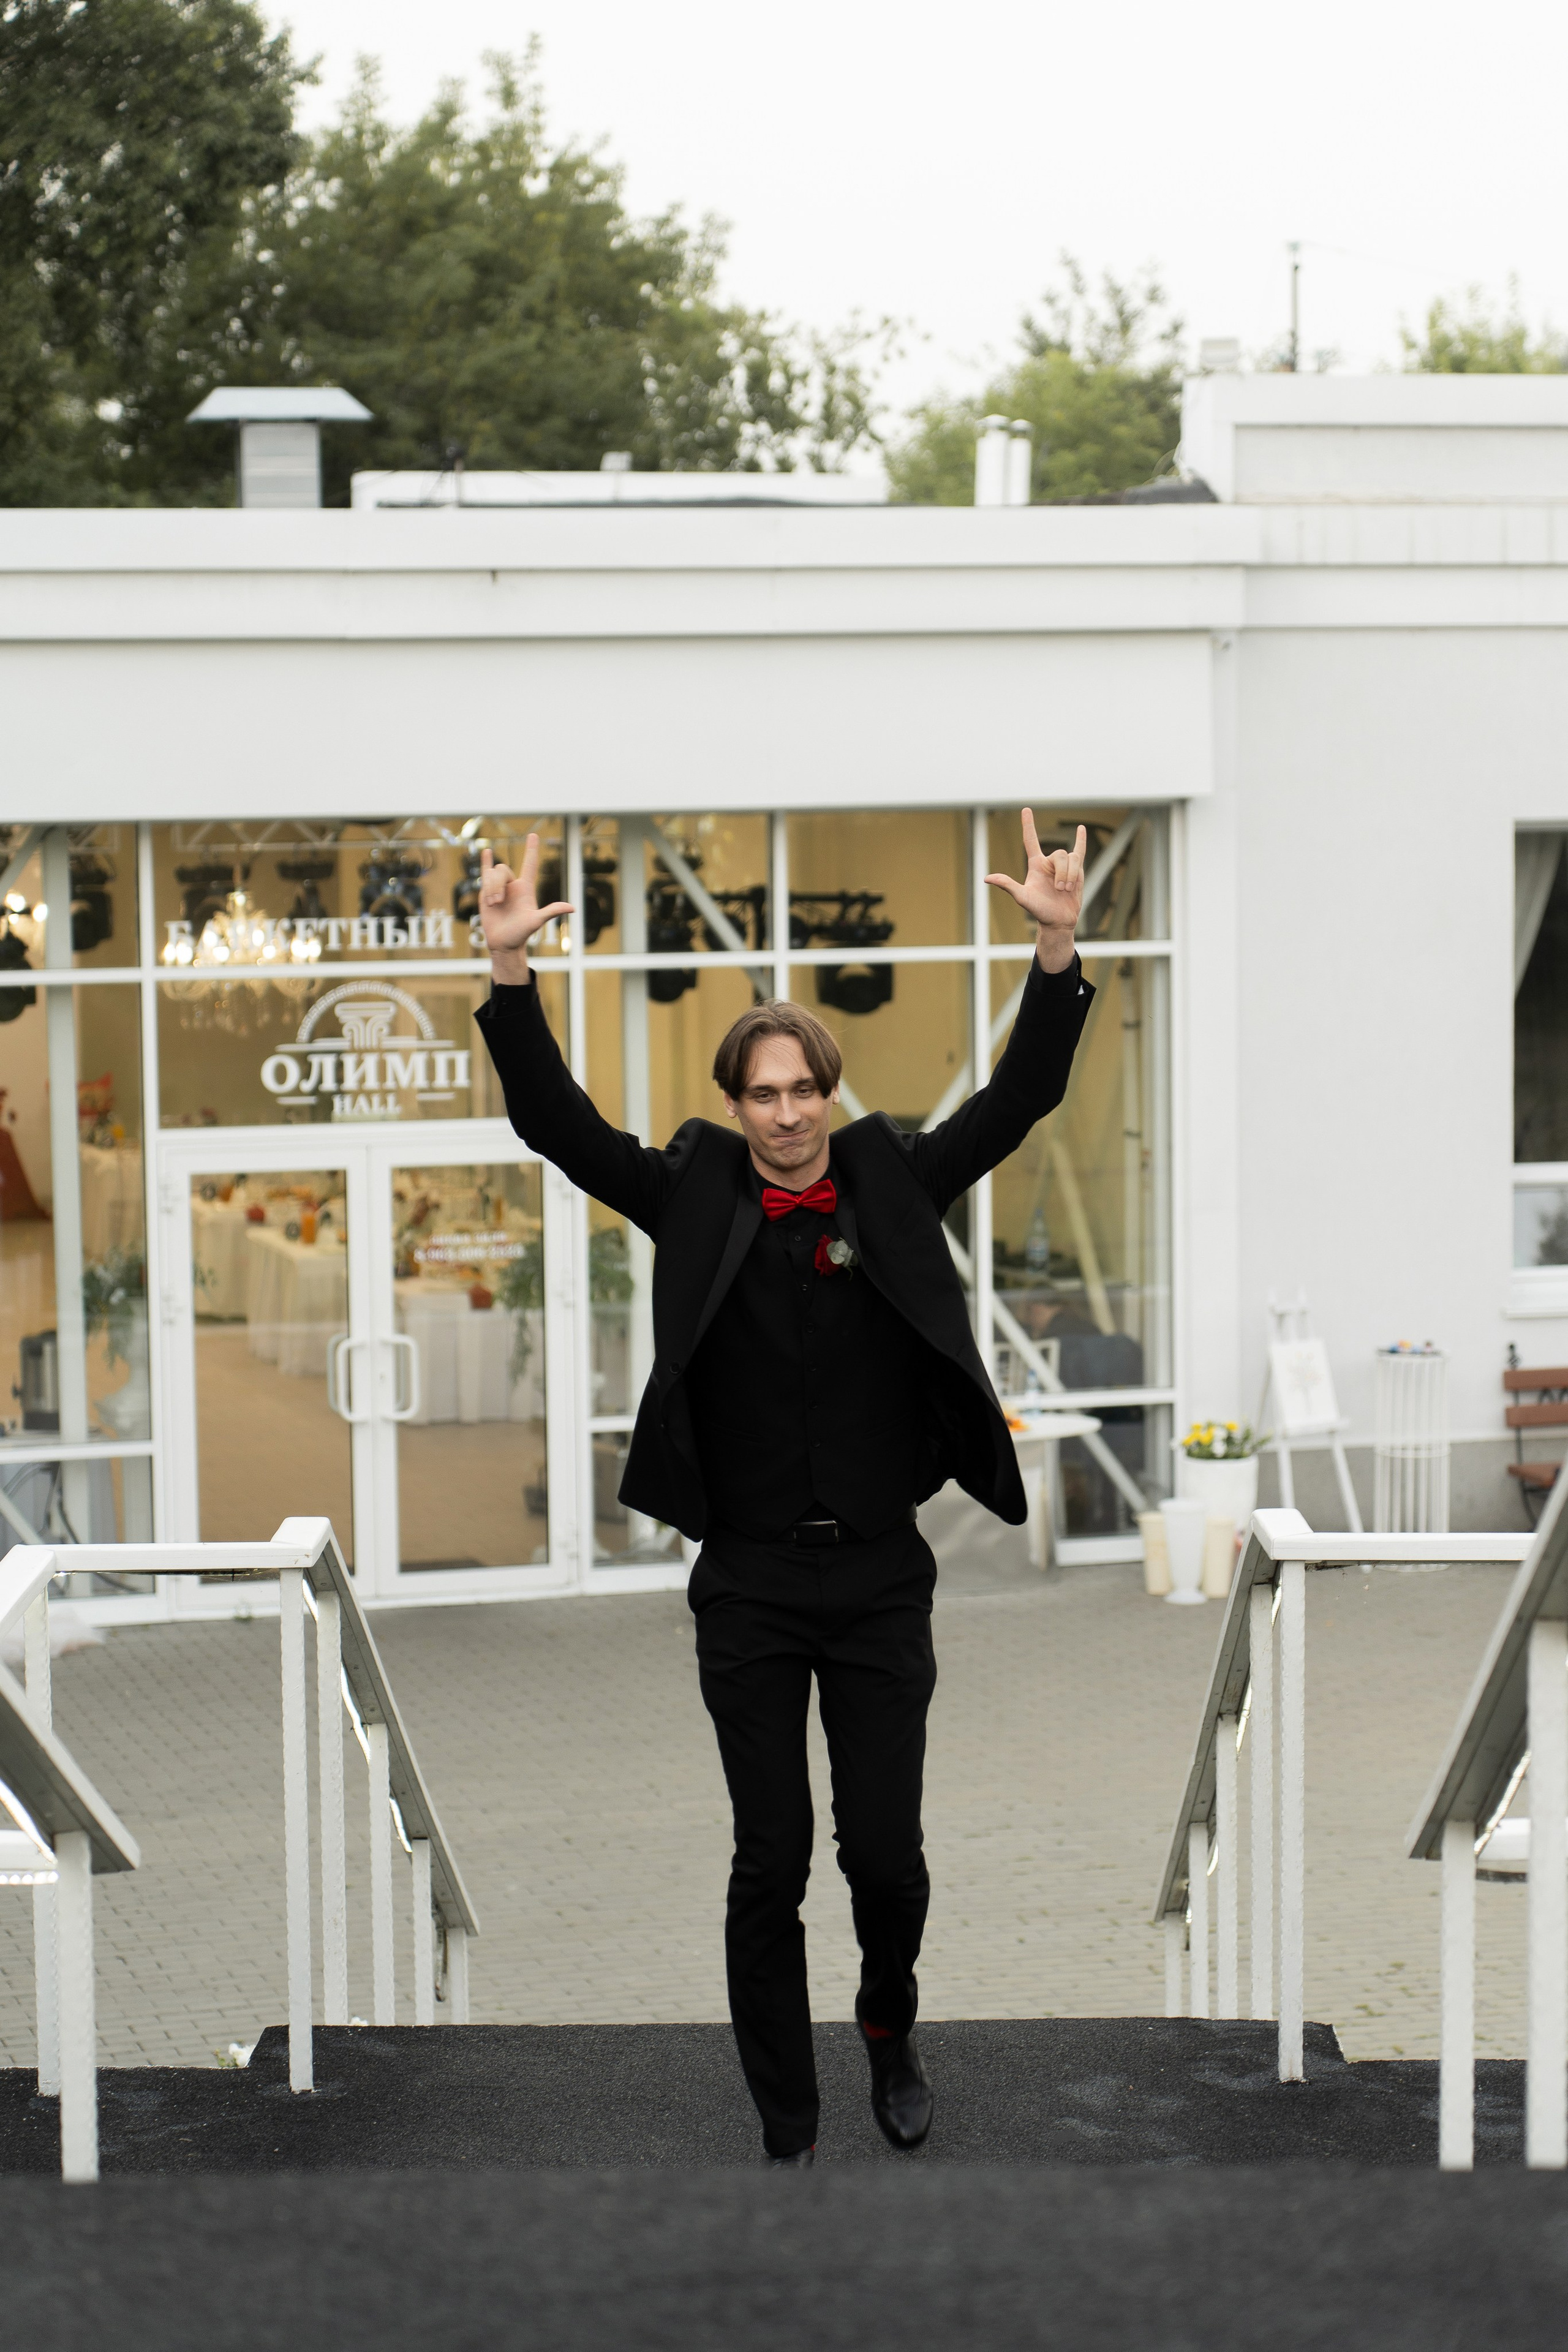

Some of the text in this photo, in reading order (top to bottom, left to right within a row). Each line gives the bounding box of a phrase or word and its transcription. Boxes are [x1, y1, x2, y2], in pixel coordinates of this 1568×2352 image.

[469, 914, 559, 948] ЗЛ
[260, 1049, 470, 1094] ОЛИМП
[333, 1092, 402, 1115] HALL
